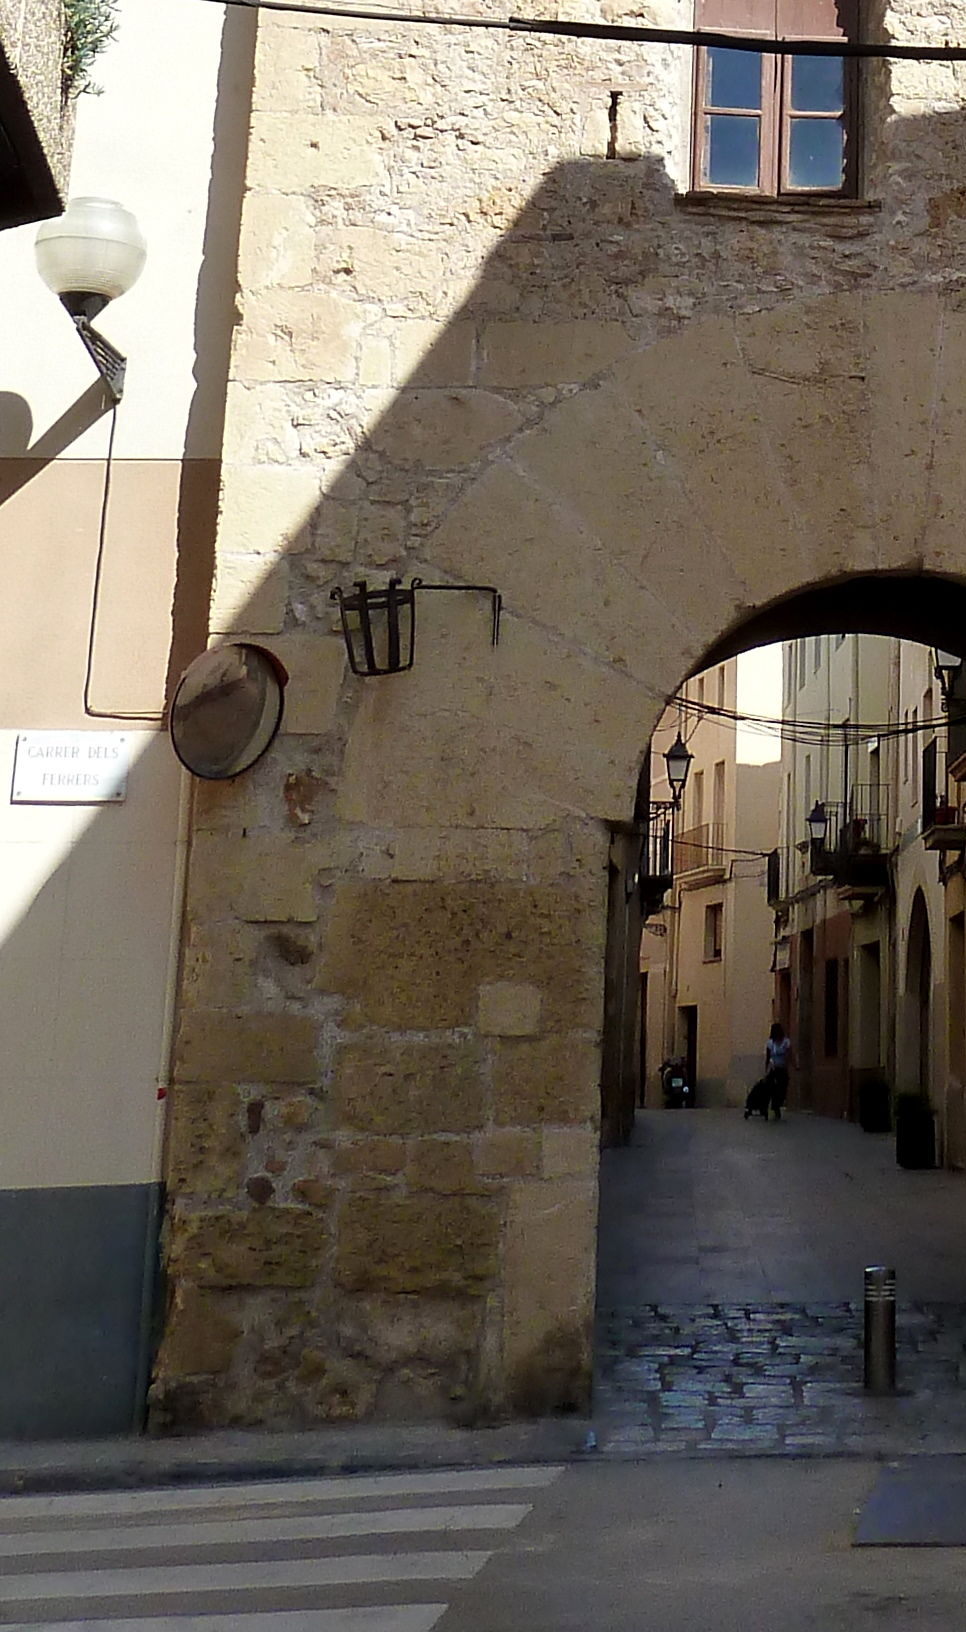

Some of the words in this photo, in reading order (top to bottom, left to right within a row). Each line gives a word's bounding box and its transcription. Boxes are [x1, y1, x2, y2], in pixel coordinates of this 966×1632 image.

[28, 745, 80, 759] CARRER
[87, 745, 120, 759] DELS
[41, 772, 100, 786] FERRERS
